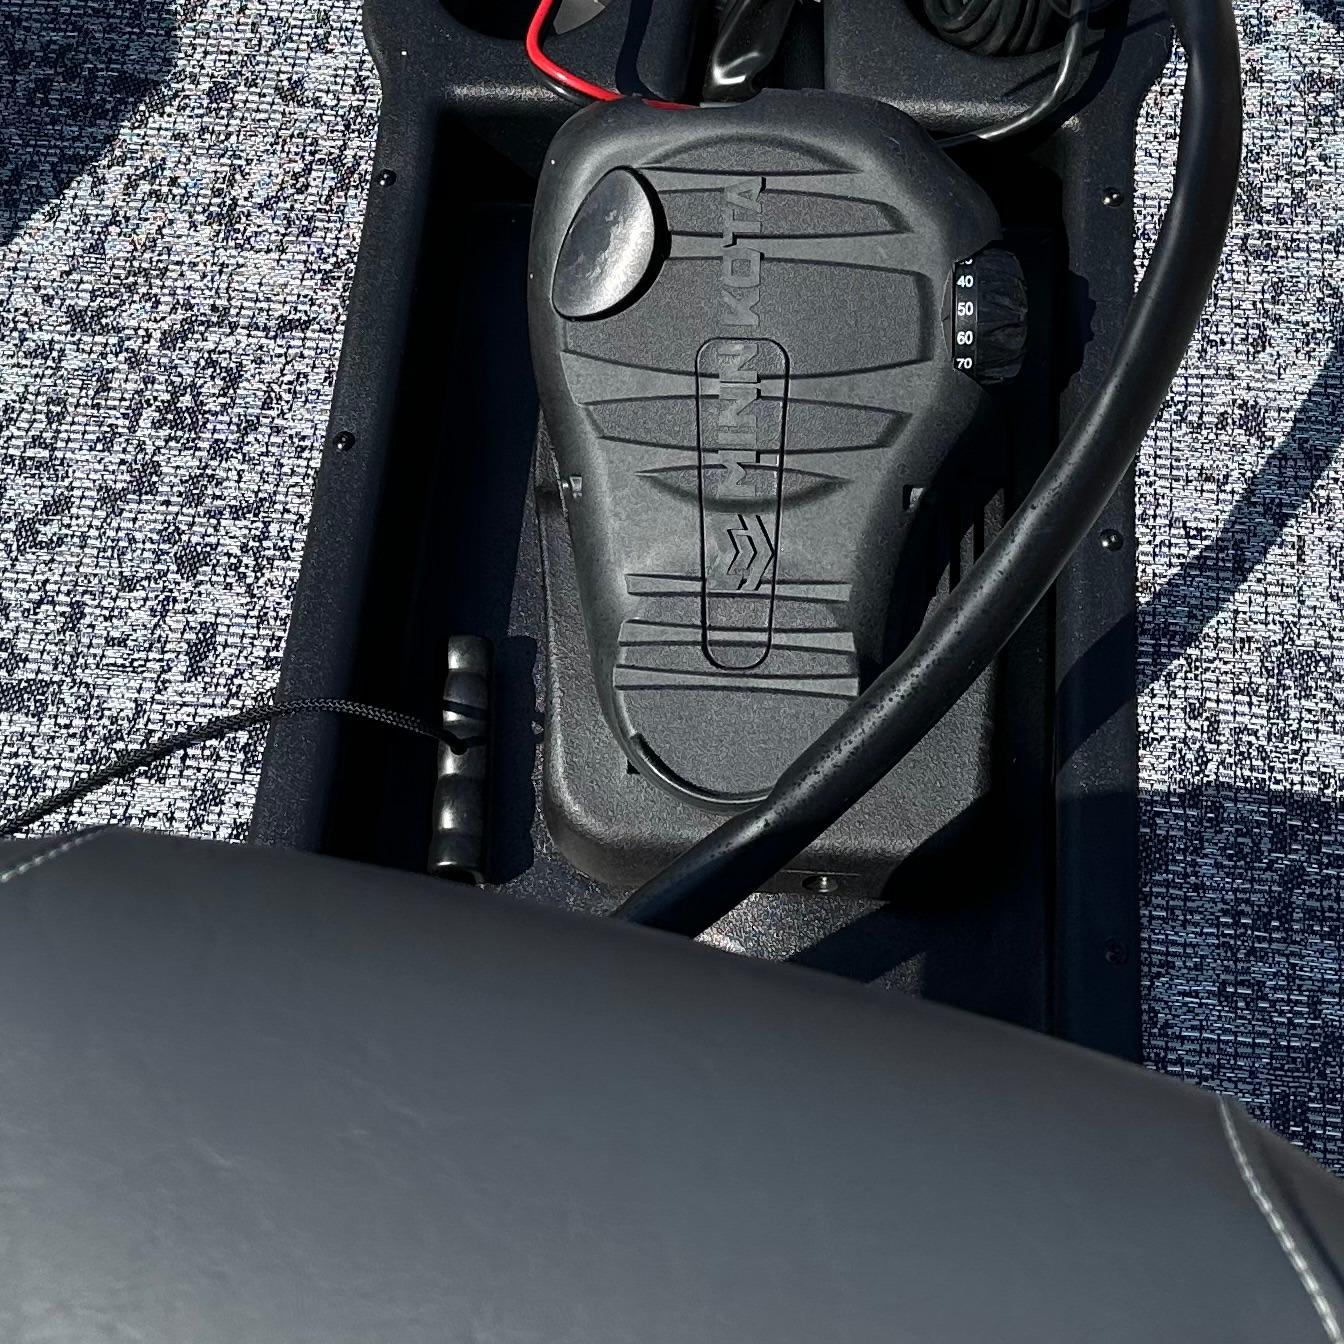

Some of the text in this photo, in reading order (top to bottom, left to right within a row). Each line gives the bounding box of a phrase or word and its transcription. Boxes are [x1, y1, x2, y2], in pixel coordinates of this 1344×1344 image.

[956, 275, 974, 288] 40
[957, 301, 974, 316] 50
[718, 175, 766, 498] MINN KOTA
[956, 330, 974, 345] 60
[955, 357, 973, 370] 70
